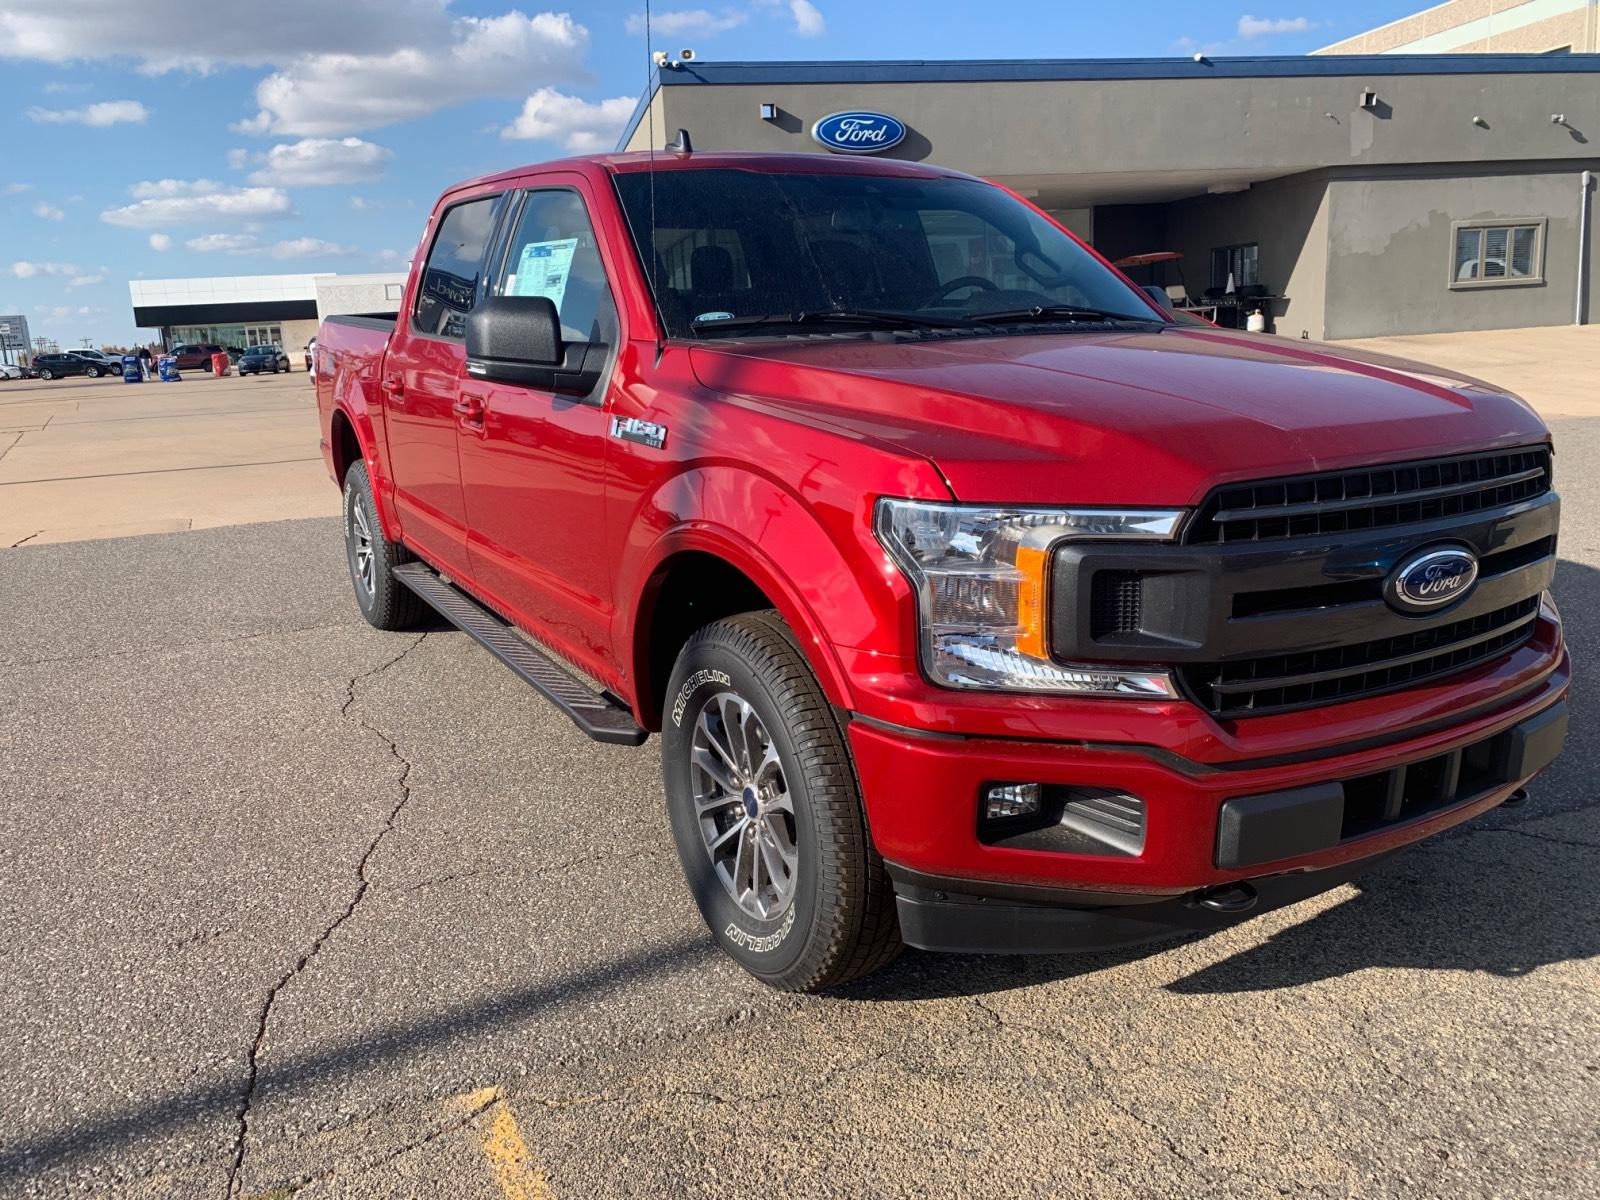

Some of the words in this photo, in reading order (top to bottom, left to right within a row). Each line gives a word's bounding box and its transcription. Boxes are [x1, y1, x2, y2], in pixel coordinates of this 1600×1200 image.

[835, 118, 887, 142] Ford
[1419, 562, 1465, 595] Ford
[671, 669, 731, 728] MICHELIN
[725, 902, 796, 953] MICHELIN
